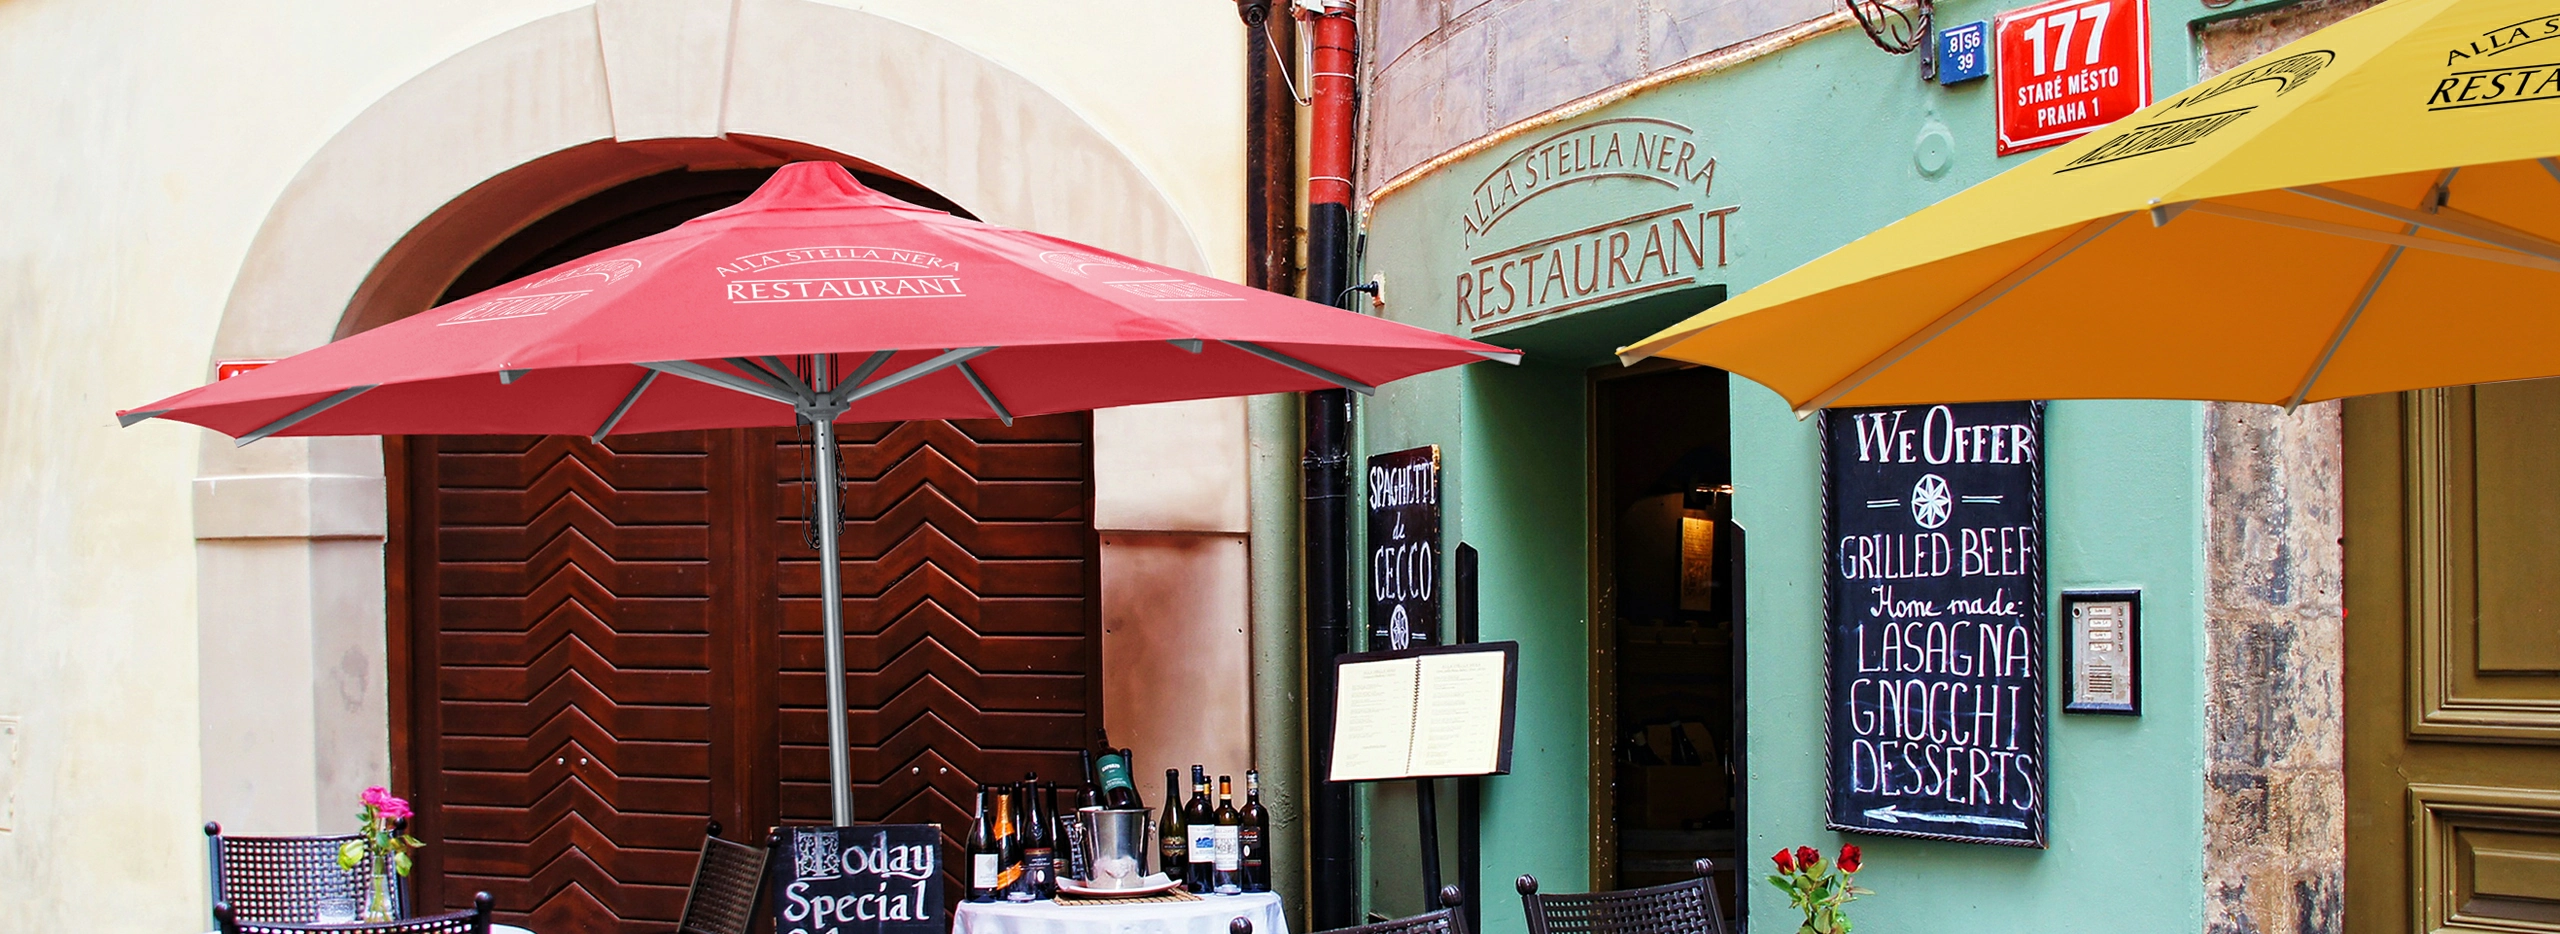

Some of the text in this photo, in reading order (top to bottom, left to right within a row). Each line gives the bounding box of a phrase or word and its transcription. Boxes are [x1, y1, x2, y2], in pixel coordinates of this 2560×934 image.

[2024, 2, 2111, 76] 177
[2447, 27, 2530, 67] ALLA
[2018, 66, 2119, 107] STARÉ MĚSTO
[2037, 97, 2100, 128] PRAHA 1
[2066, 111, 2251, 166] RESTAURANT
[1462, 132, 1717, 250] ALLA STELLA NERA
[716, 248, 959, 277] ALLA STELLA NERA
[1456, 204, 1741, 326] RESTAURANT
[727, 278, 962, 300] RESTAURANT
[1369, 461, 1436, 510] SPAGHETTI
[1392, 512, 1406, 541] de
[1374, 541, 1432, 602] CECCO
[1840, 527, 2033, 579] GRILLED BEEF
[1870, 585, 2026, 618] Home made:
[1858, 621, 2031, 678] LASAGNA
[1851, 679, 2022, 750] GNOCCHI
[1853, 739, 2035, 811] DESSERTS
[795, 829, 935, 881] Today
[784, 880, 930, 930] Special
